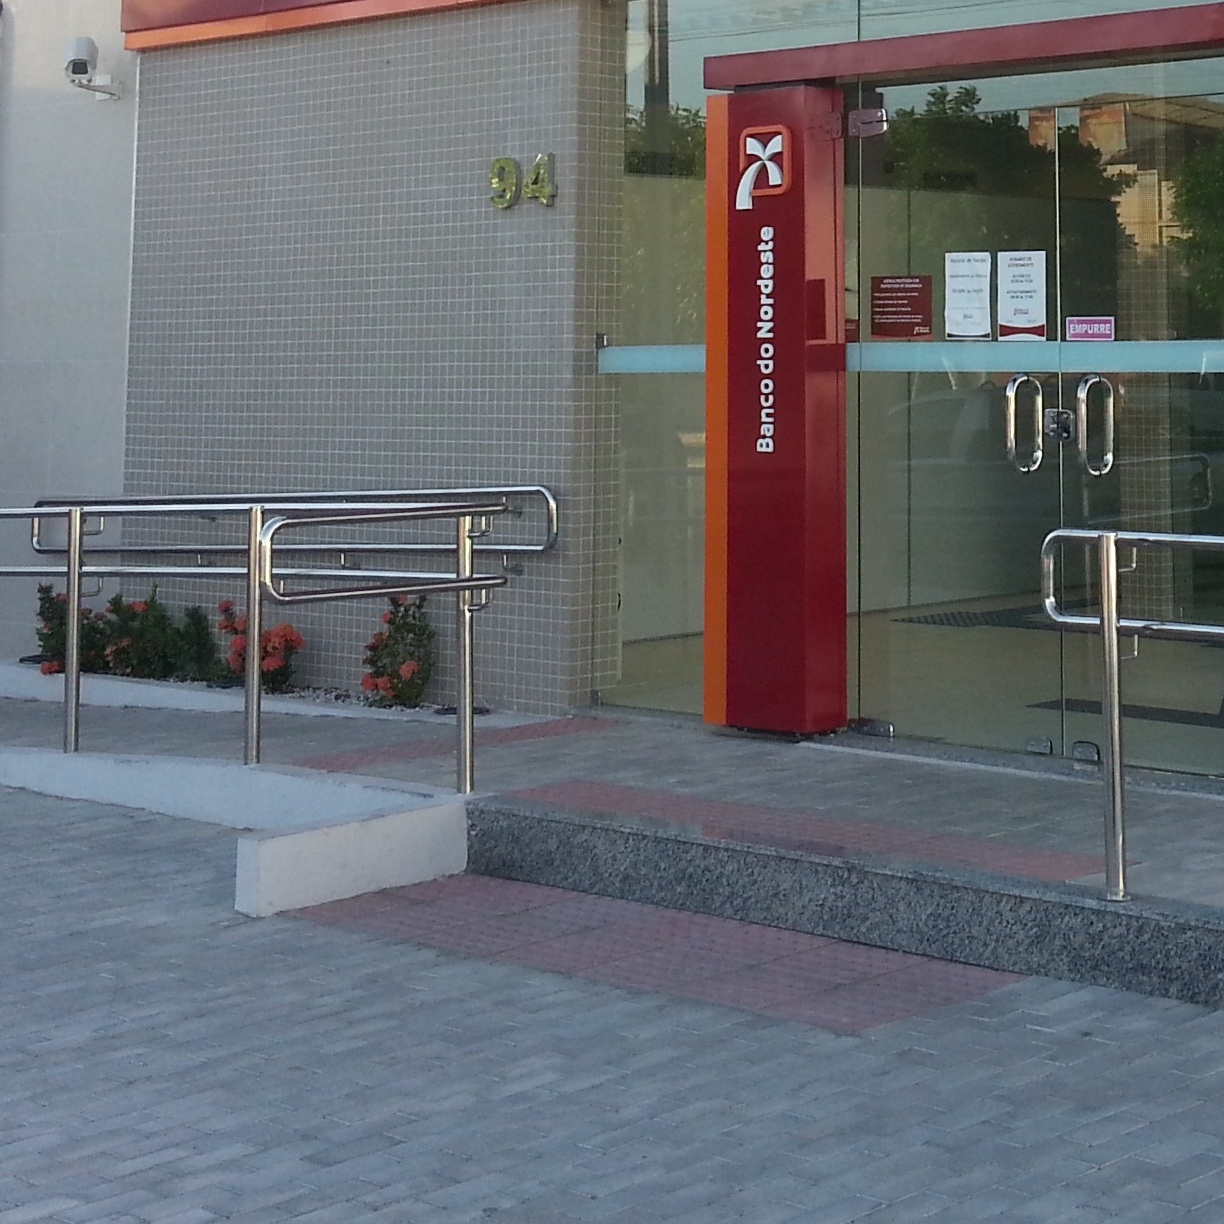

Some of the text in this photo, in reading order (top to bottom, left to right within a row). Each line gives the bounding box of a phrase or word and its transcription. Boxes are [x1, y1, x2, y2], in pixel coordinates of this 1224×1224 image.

[489, 153, 556, 208] 94
[756, 226, 775, 454] Banco do Nordeste
[1069, 322, 1112, 335] EMPURRE
